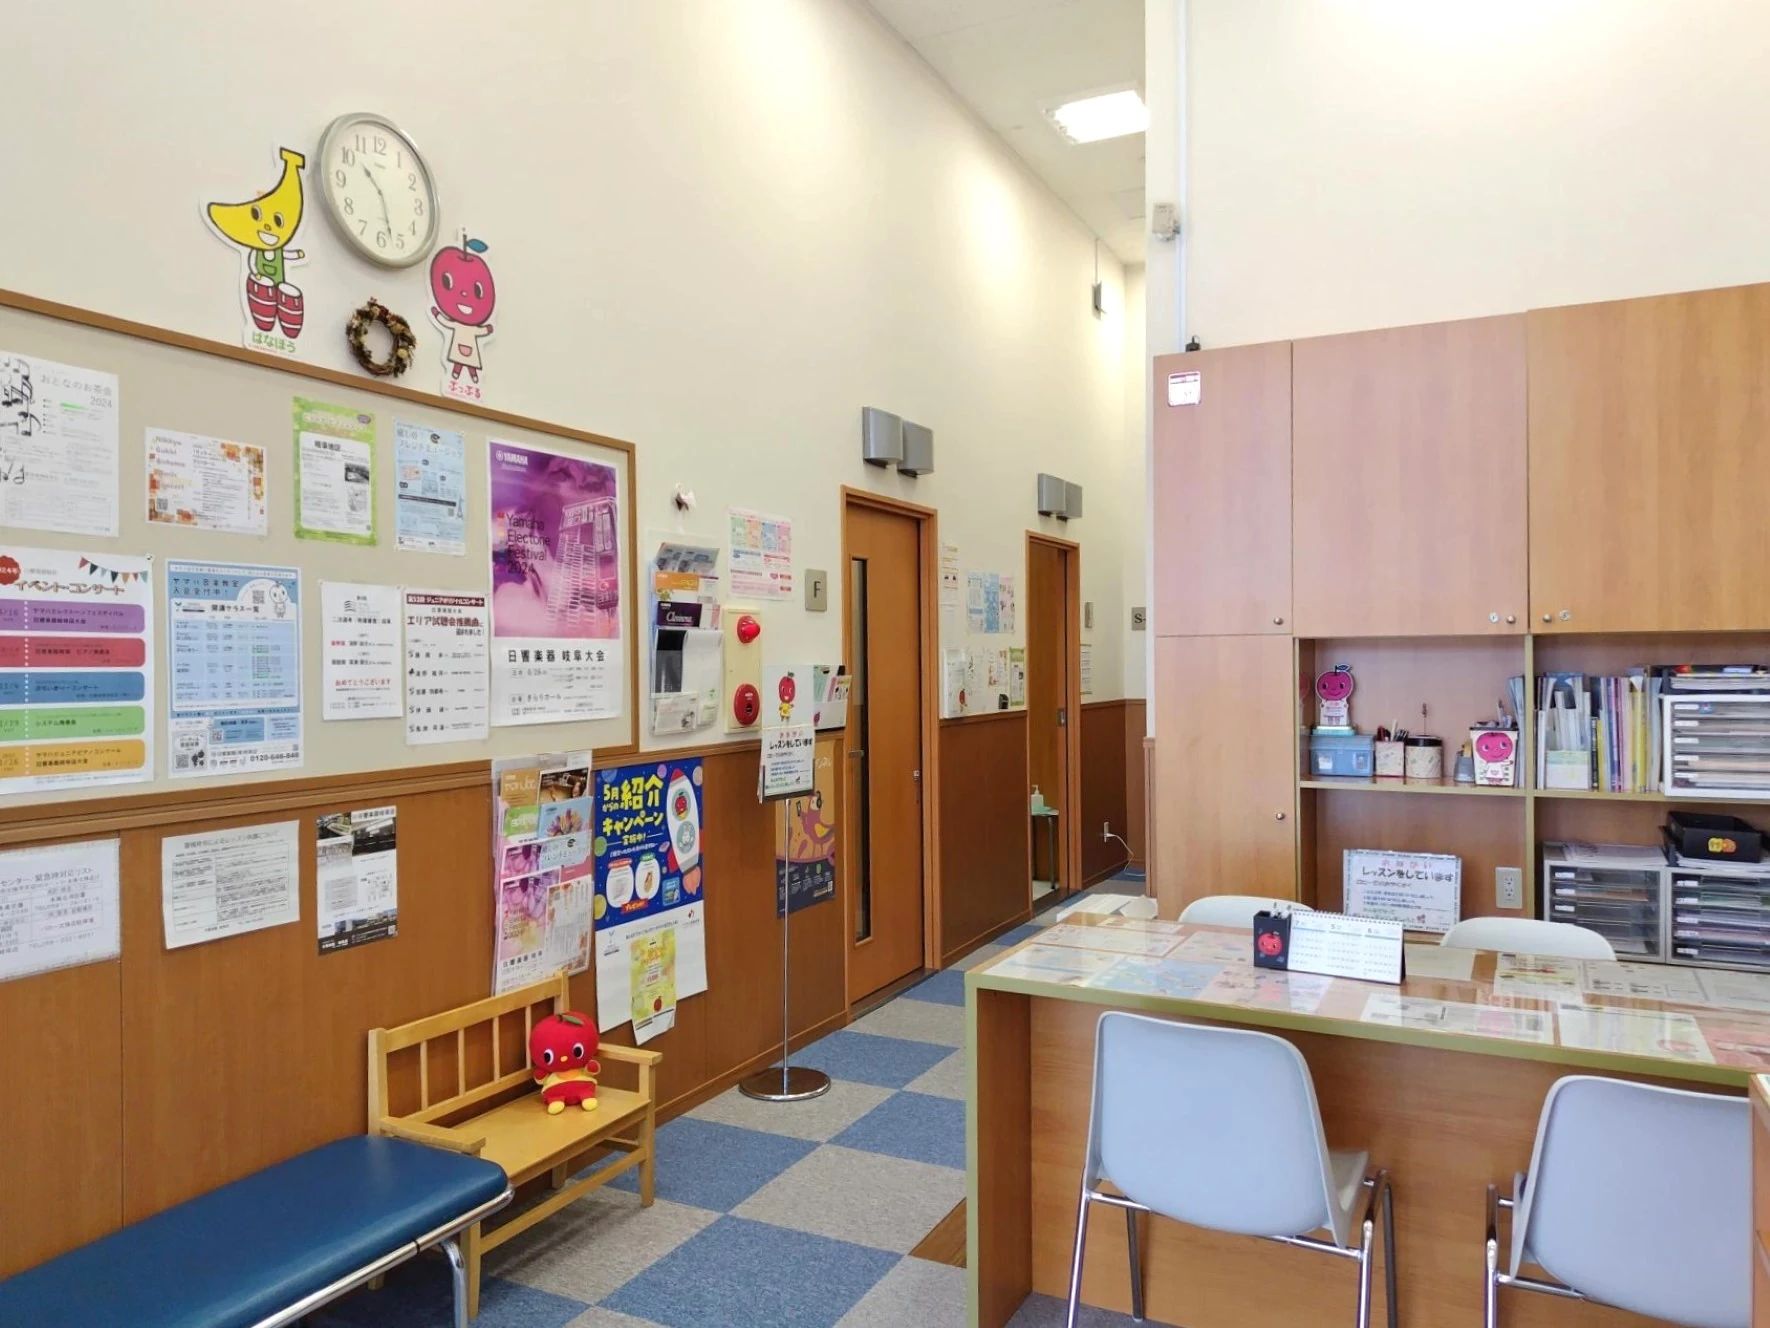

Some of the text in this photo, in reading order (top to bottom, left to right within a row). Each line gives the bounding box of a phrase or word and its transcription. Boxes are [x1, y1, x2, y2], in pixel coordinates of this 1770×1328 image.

[354, 134, 367, 155] 11
[373, 135, 387, 156] 12
[341, 146, 355, 168] 10
[397, 151, 402, 169] 1
[335, 169, 347, 188] 9
[408, 174, 418, 191] 2
[343, 197, 354, 216] 8
[414, 198, 424, 216] 3
[358, 219, 368, 236] 7
[408, 220, 417, 236] 4
[376, 230, 387, 248] 6
[395, 234, 405, 250] 5
[503, 451, 529, 466] YAMAHA
[506, 512, 545, 532] Yamaha
[507, 528, 550, 546] Electone
[507, 543, 547, 561] Festival
[507, 560, 535, 575] 2024
[812, 580, 821, 599] F
[562, 649, 605, 663] 岐阜大会
[603, 782, 620, 801] 5月
[620, 773, 664, 811] 紹介
[602, 810, 665, 837] キャンペーン
[1361, 865, 1455, 882] レッスンをしています
